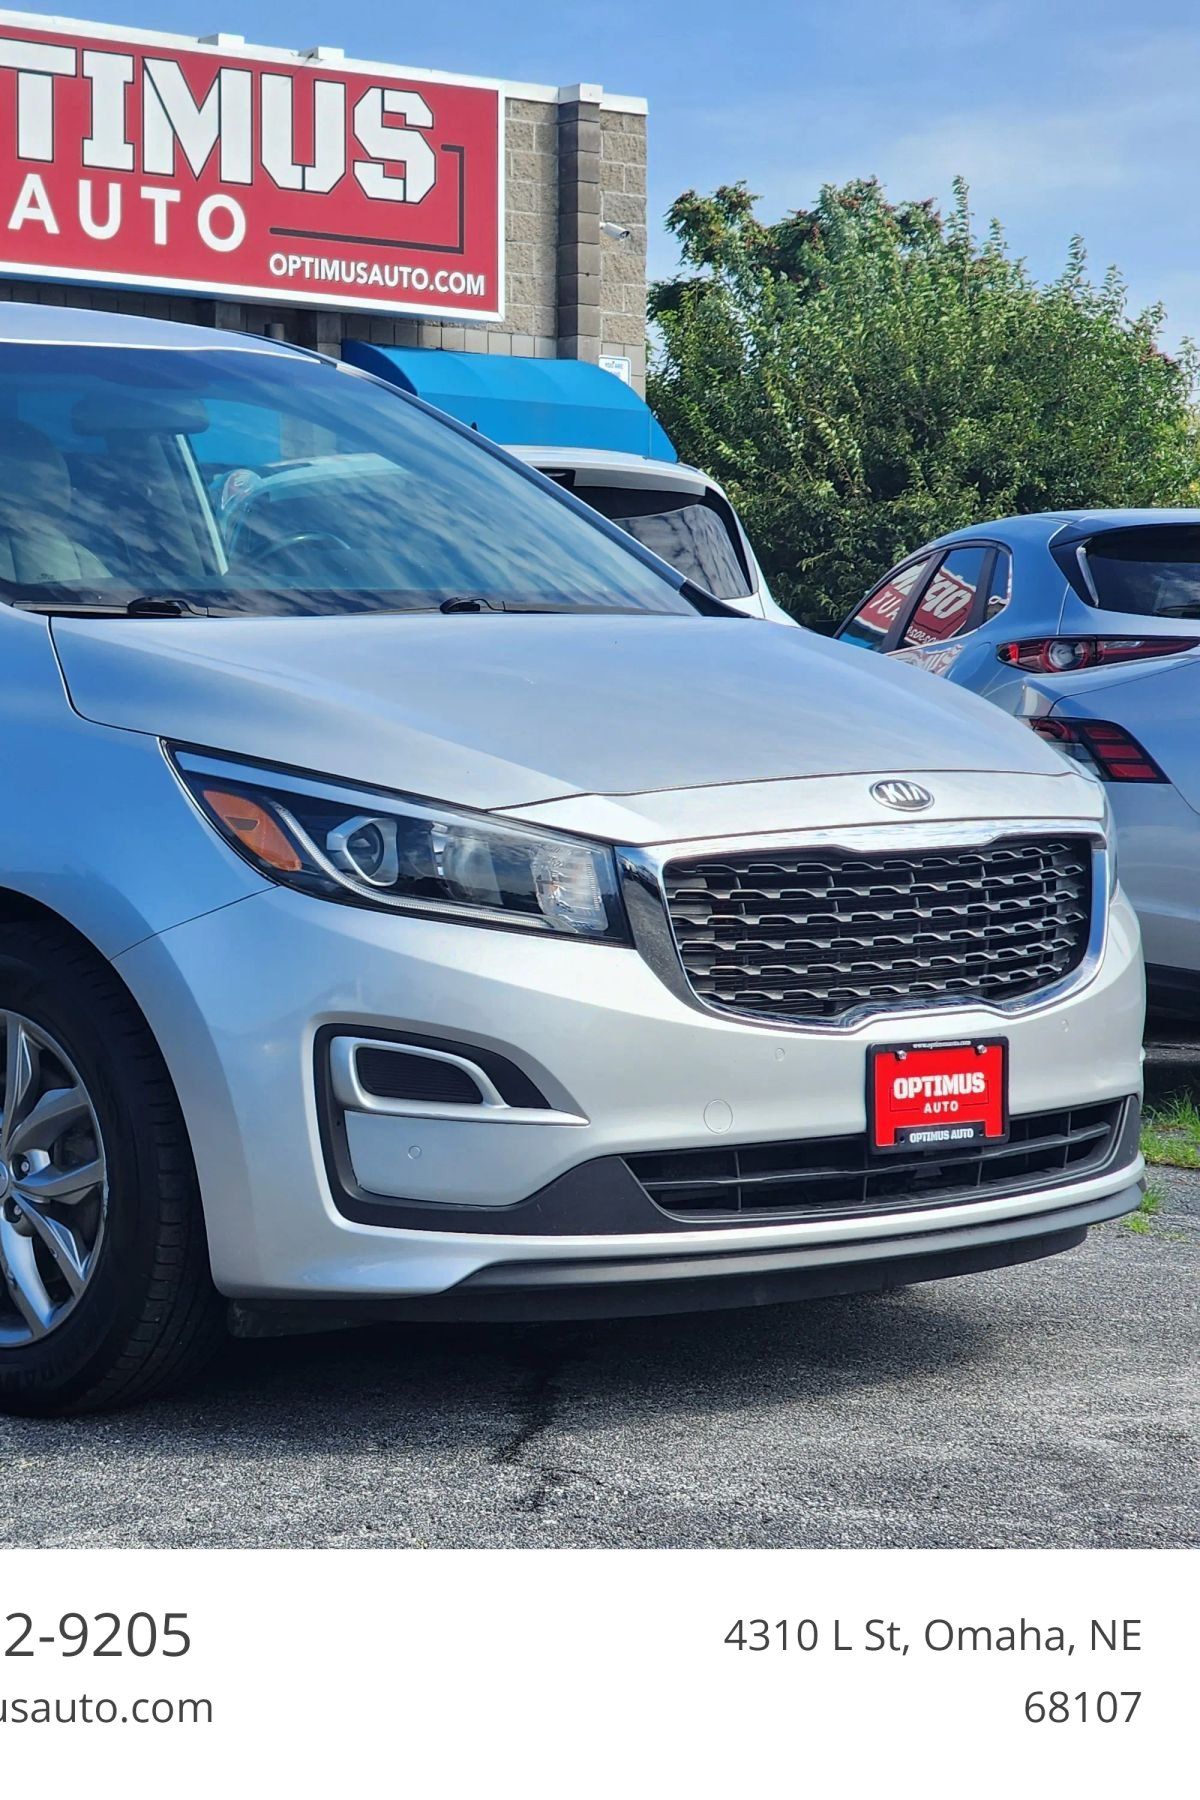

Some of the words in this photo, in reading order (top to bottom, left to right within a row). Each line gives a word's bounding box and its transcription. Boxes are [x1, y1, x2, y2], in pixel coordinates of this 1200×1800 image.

[7, 172, 247, 253] AUTO
[268, 253, 486, 297] OPTIMUSAUTO.COM
[877, 782, 929, 803] KIA
[893, 1071, 986, 1100] OPTIMUS
[923, 1100, 959, 1114] AUTO
[909, 1130, 950, 1144] OPTIMUS
[950, 1127, 975, 1140] AUTO
